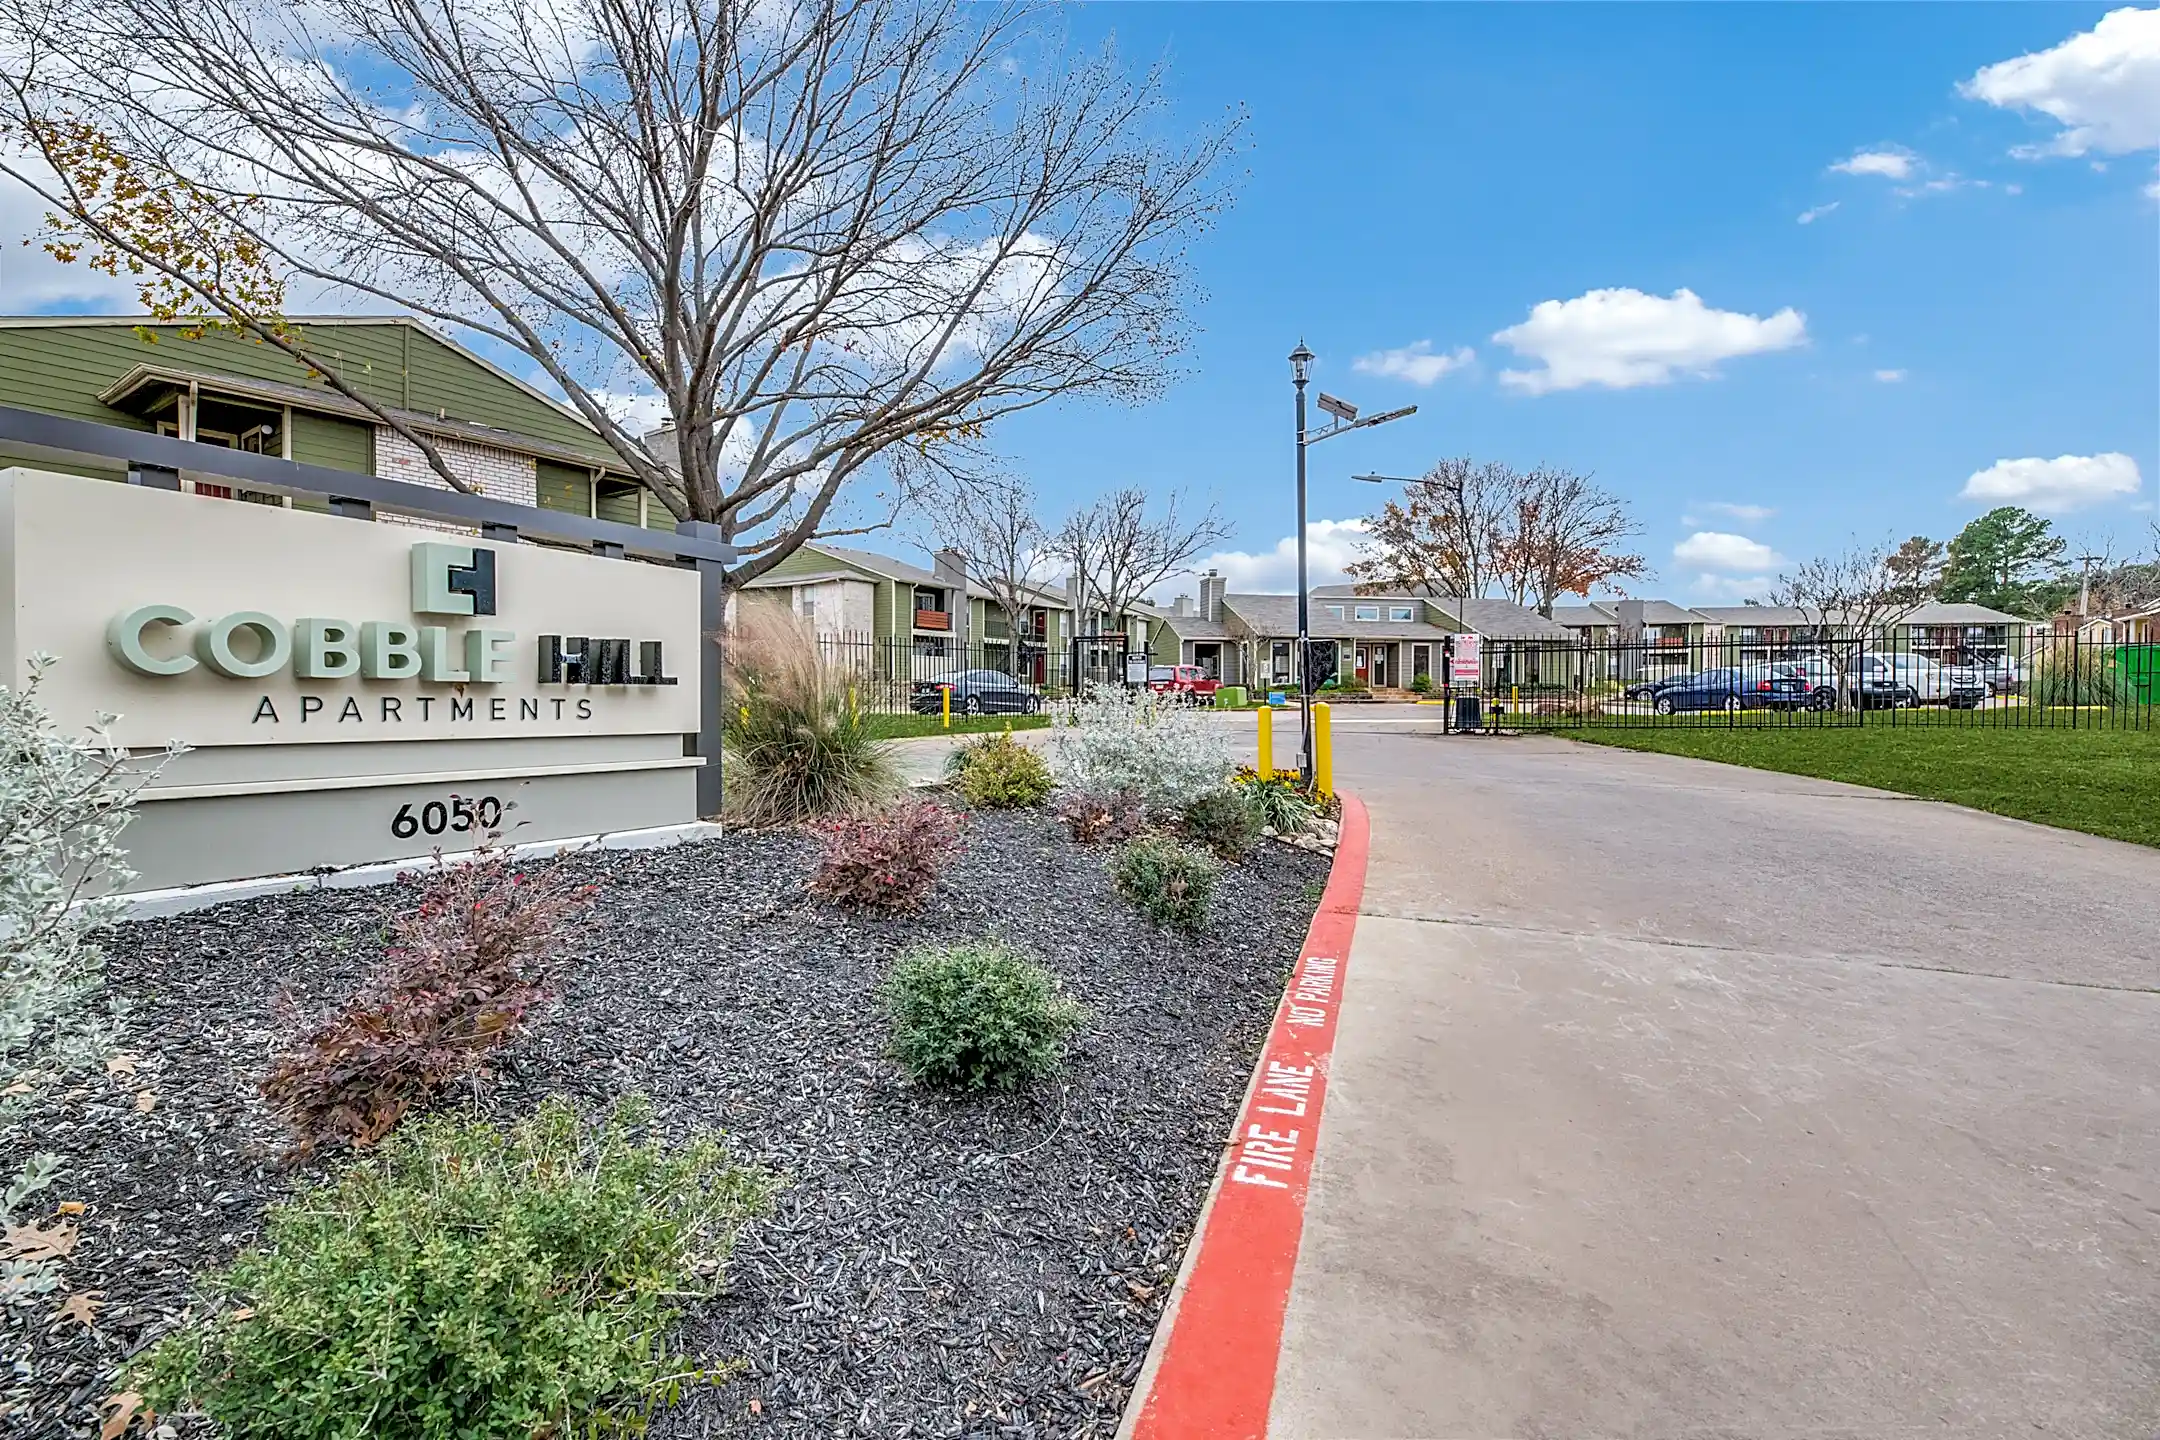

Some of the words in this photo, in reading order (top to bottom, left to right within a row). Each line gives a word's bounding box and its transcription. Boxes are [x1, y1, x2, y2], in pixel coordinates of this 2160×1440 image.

[107, 604, 516, 684] COBBLE
[538, 634, 679, 685] HILL
[252, 695, 593, 724] APARTMENTS
[391, 796, 502, 839] 6050
[1295, 956, 1338, 1003] PARKING
[1285, 1006, 1327, 1027] NO
[1256, 1061, 1314, 1117] LANE
[1232, 1124, 1299, 1188] FIRE
